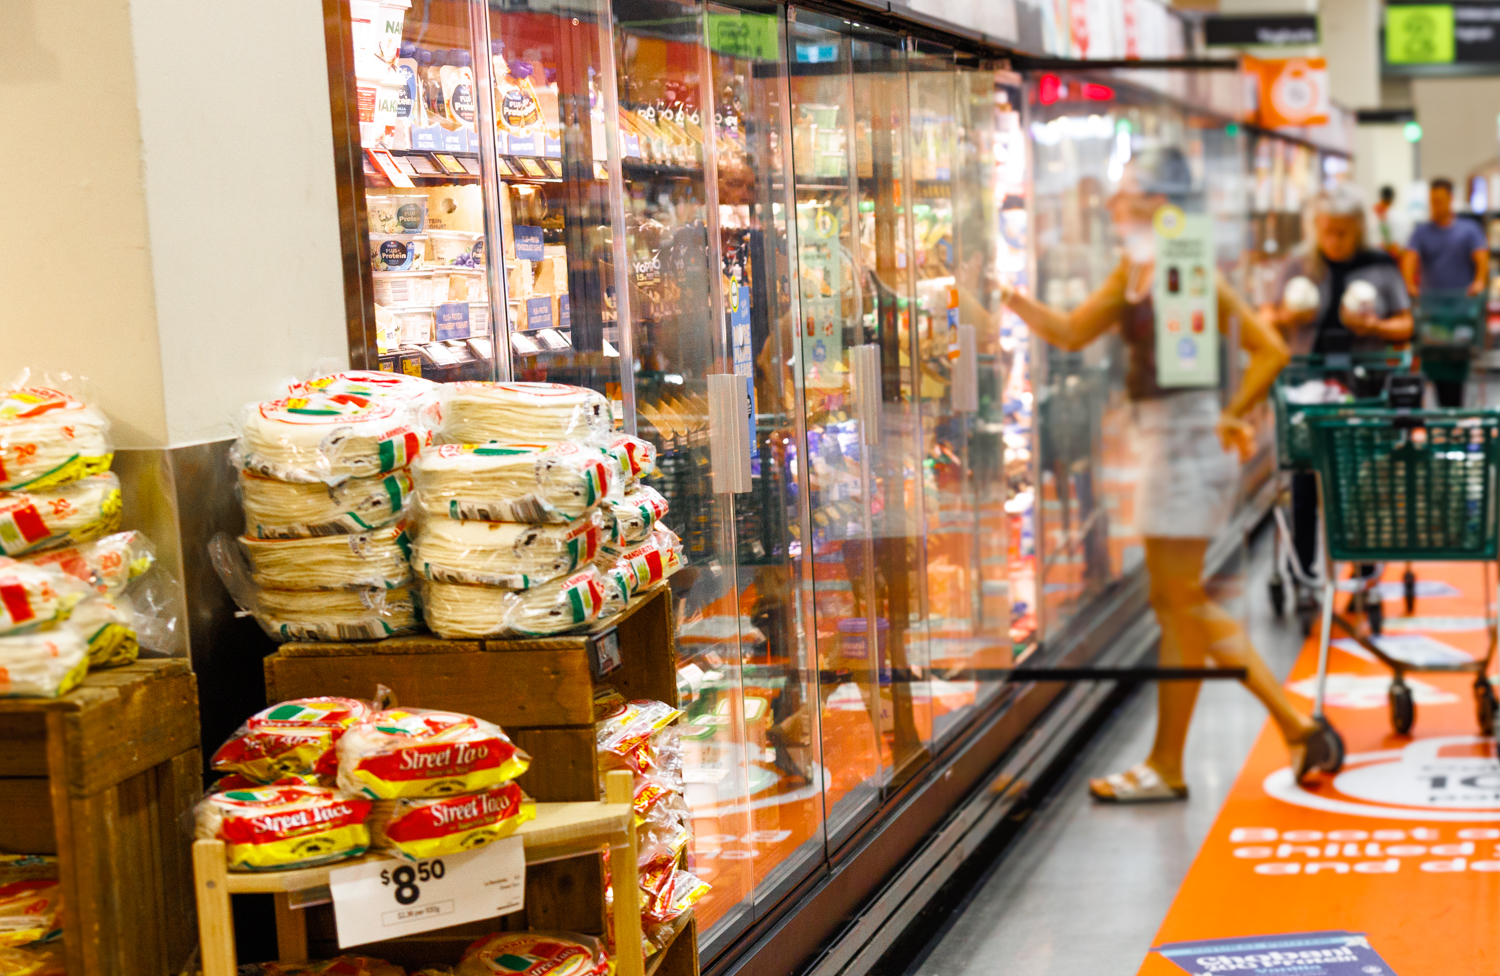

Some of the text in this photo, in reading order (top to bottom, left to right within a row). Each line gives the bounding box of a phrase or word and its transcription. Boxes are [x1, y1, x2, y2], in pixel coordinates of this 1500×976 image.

[400, 746, 452, 770] Street
[431, 798, 479, 827] Street
[252, 813, 306, 834] Street
[1234, 842, 1474, 858] chilled
[1255, 858, 1400, 876] and
